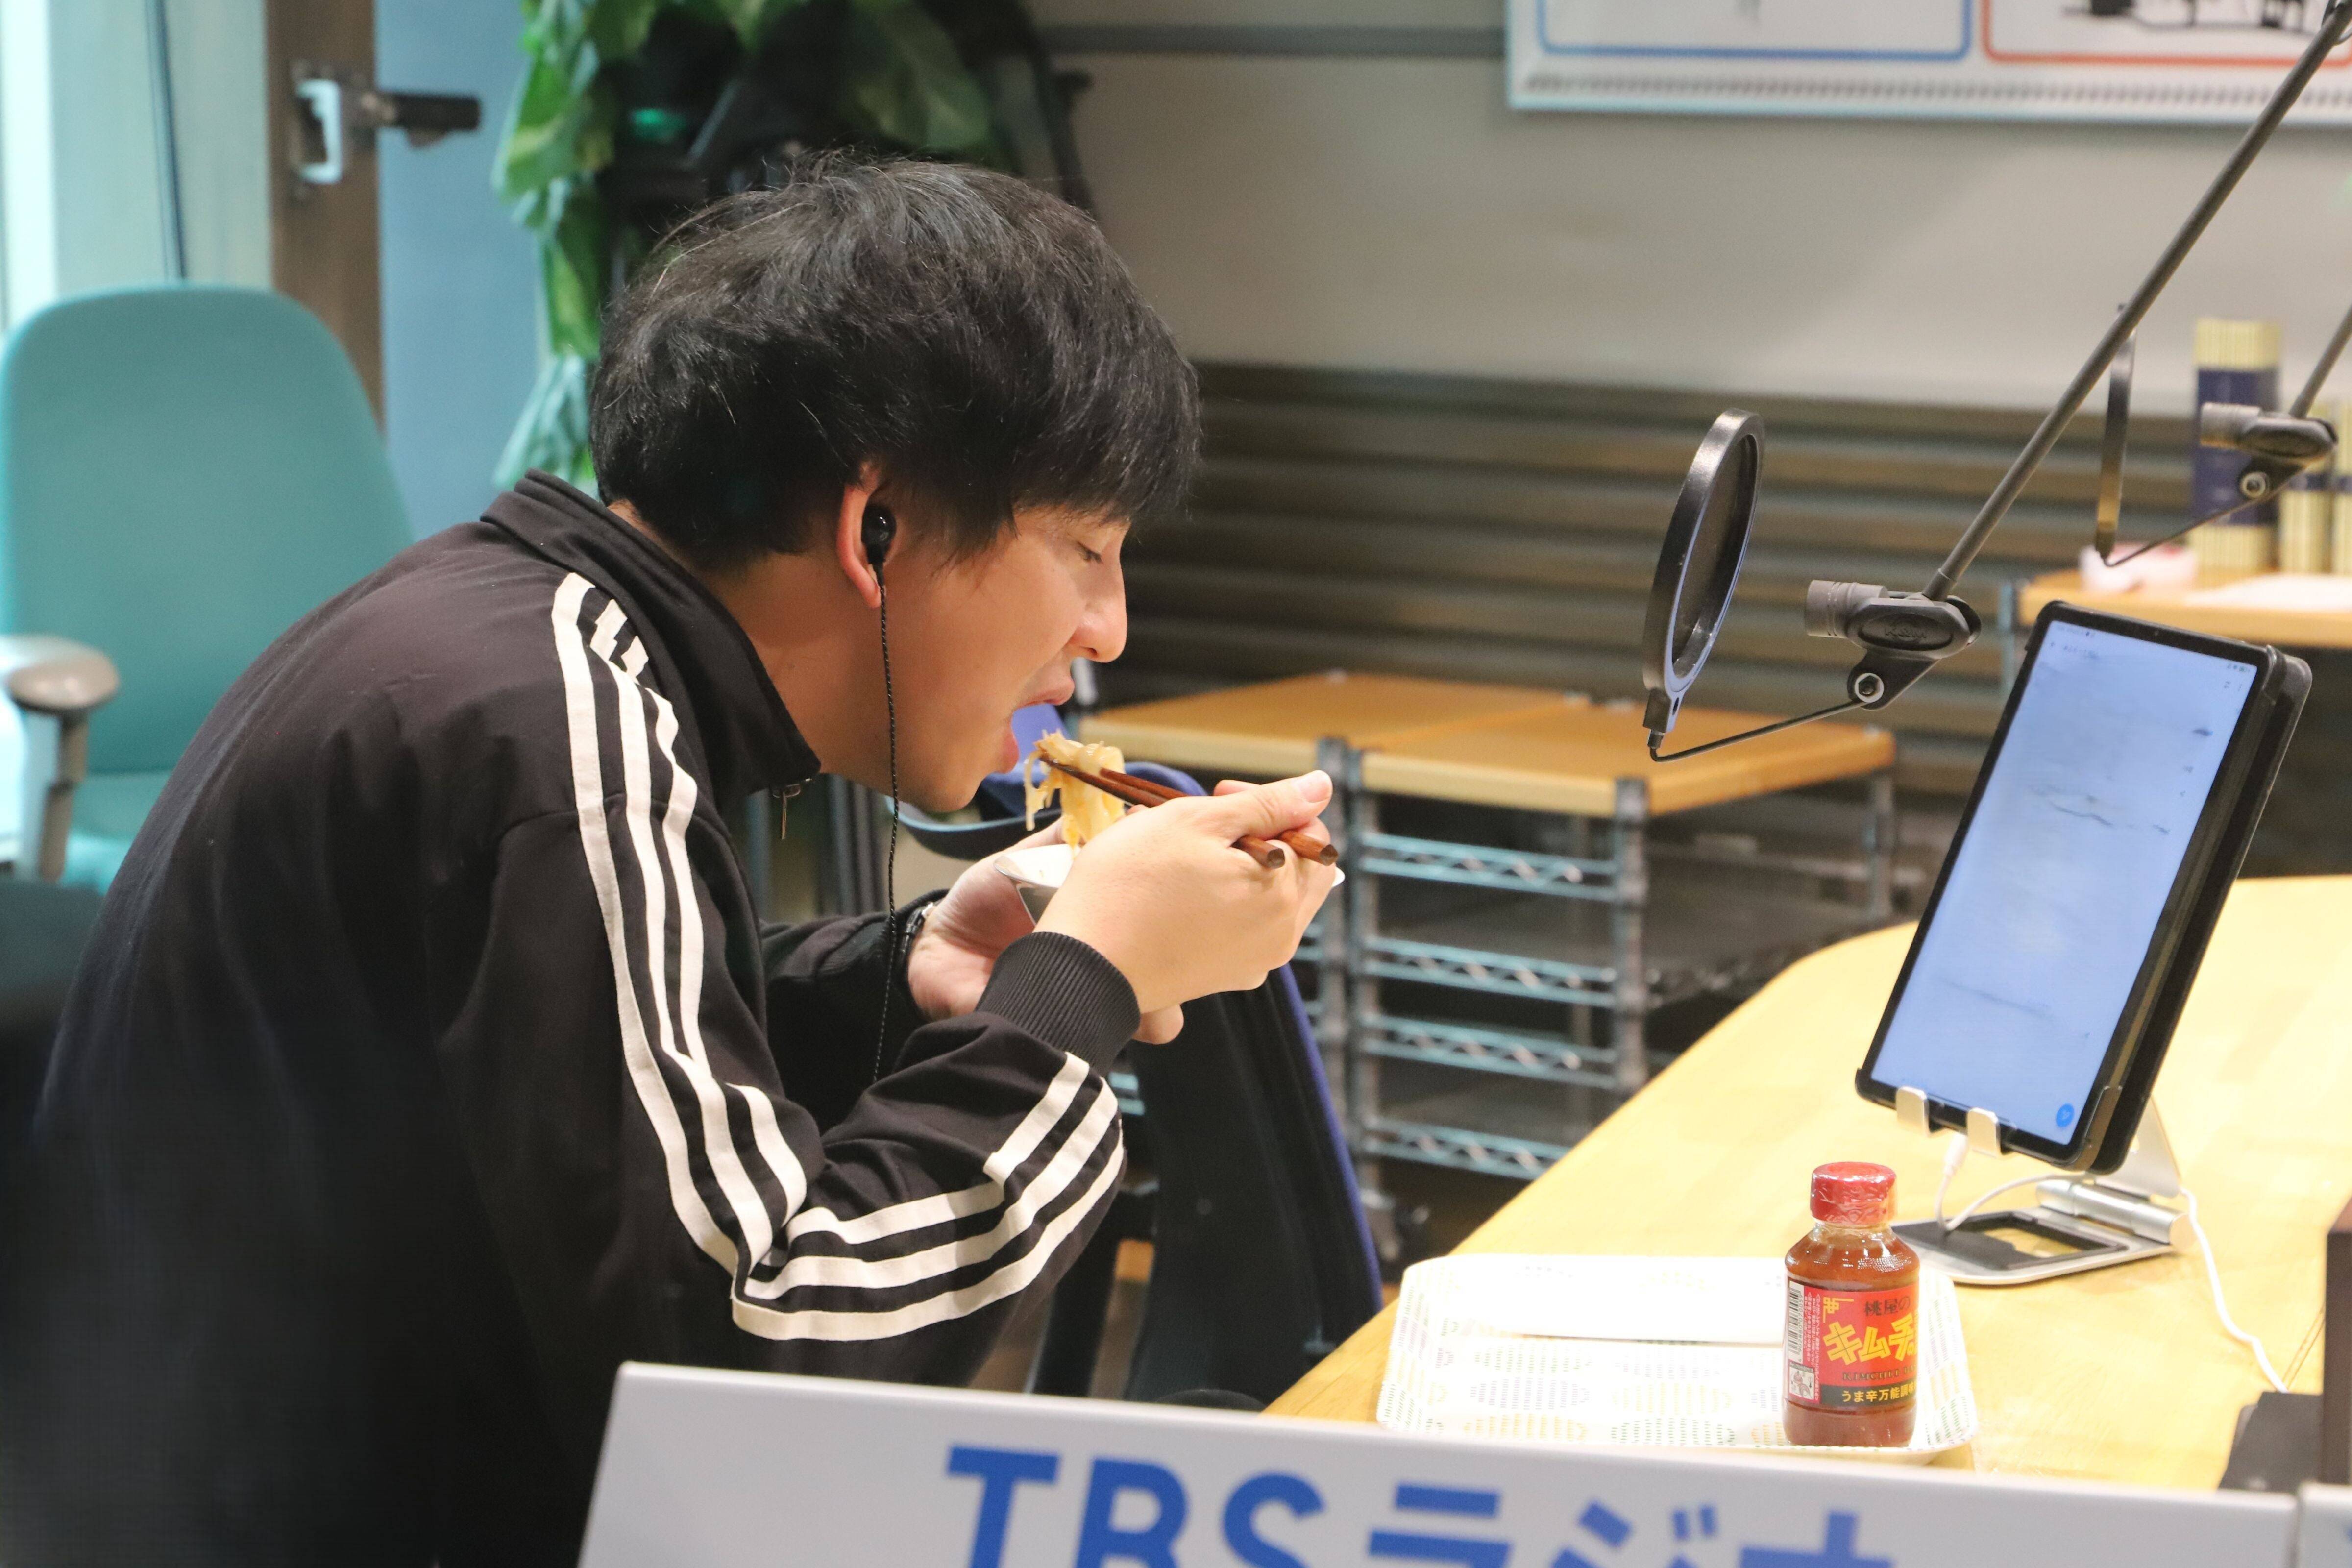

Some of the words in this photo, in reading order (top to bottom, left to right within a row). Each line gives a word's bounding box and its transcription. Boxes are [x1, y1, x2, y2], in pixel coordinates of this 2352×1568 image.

[1865, 1296, 1910, 1316] 桃屋の
[1823, 1310, 1918, 1365] キムチの
[1842, 1381, 1917, 1402] うま辛万能調味
